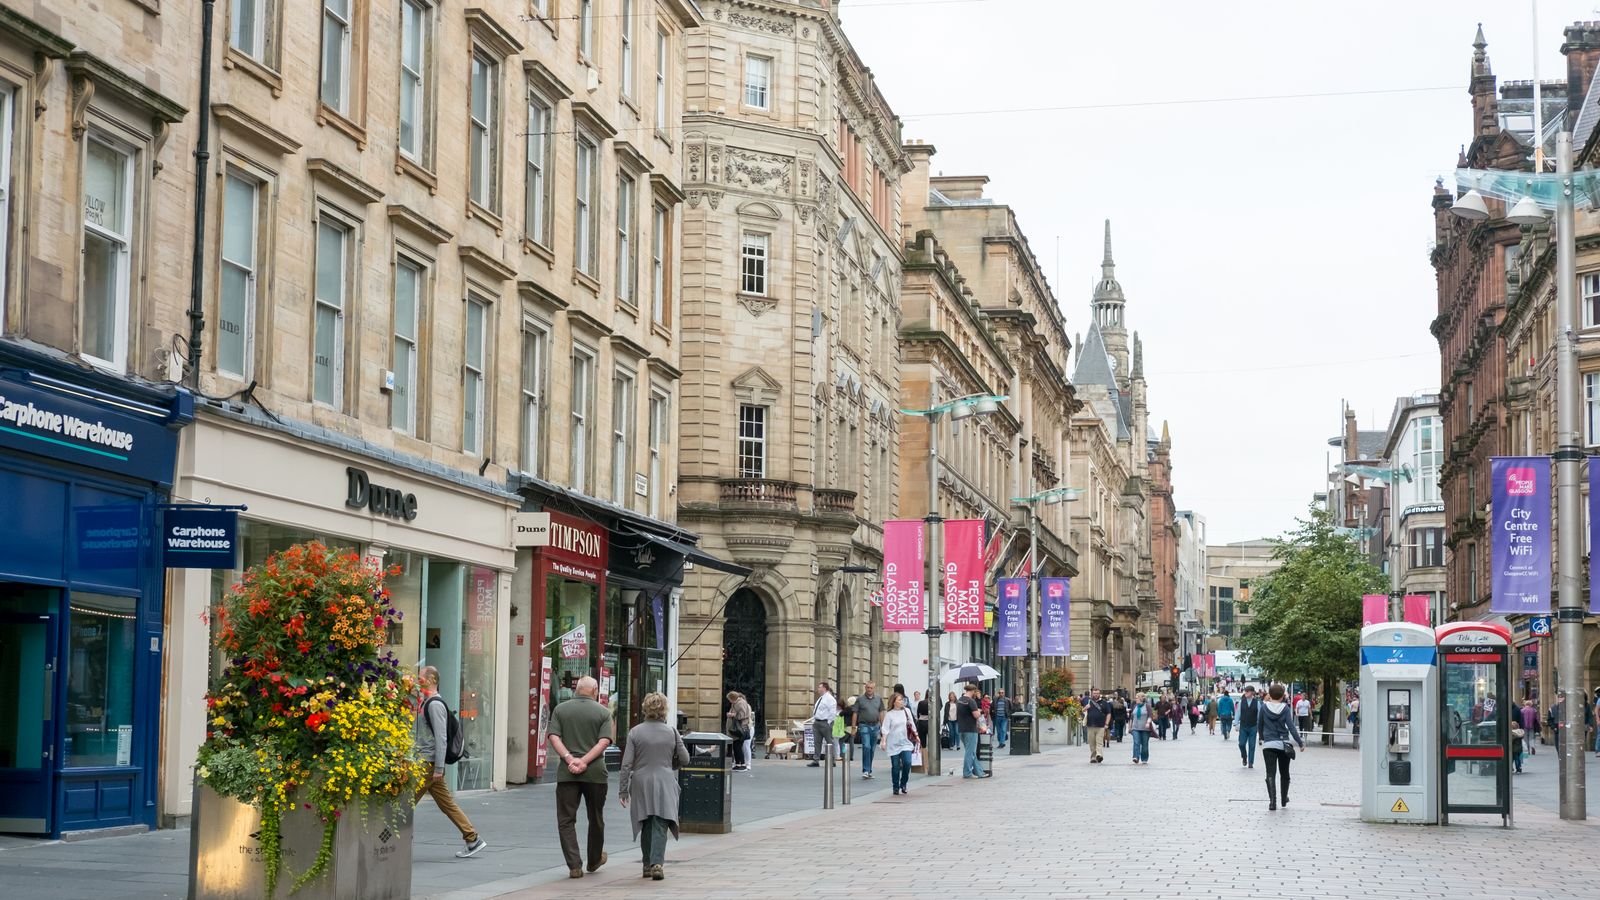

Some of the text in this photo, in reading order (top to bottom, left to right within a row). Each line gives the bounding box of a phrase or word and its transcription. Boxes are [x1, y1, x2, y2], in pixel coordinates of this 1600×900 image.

[0, 395, 133, 451] Carphone Warehouse
[345, 466, 418, 522] Dune
[1504, 520, 1538, 531] Centre
[1510, 508, 1532, 521] City
[168, 538, 231, 548] Warehouse
[172, 526, 226, 538] Carphone
[550, 522, 600, 558] TIMPSON
[1510, 533, 1532, 543] Free
[1509, 545, 1533, 556] WiFi
[886, 562, 896, 625] GLASGOW
[897, 590, 908, 624] MAKE
[908, 580, 919, 624] PEOPLE
[946, 562, 957, 625] GLASGOW
[958, 590, 968, 624] MAKE
[968, 580, 979, 624] PEOPLE
[239, 845, 252, 854] the
